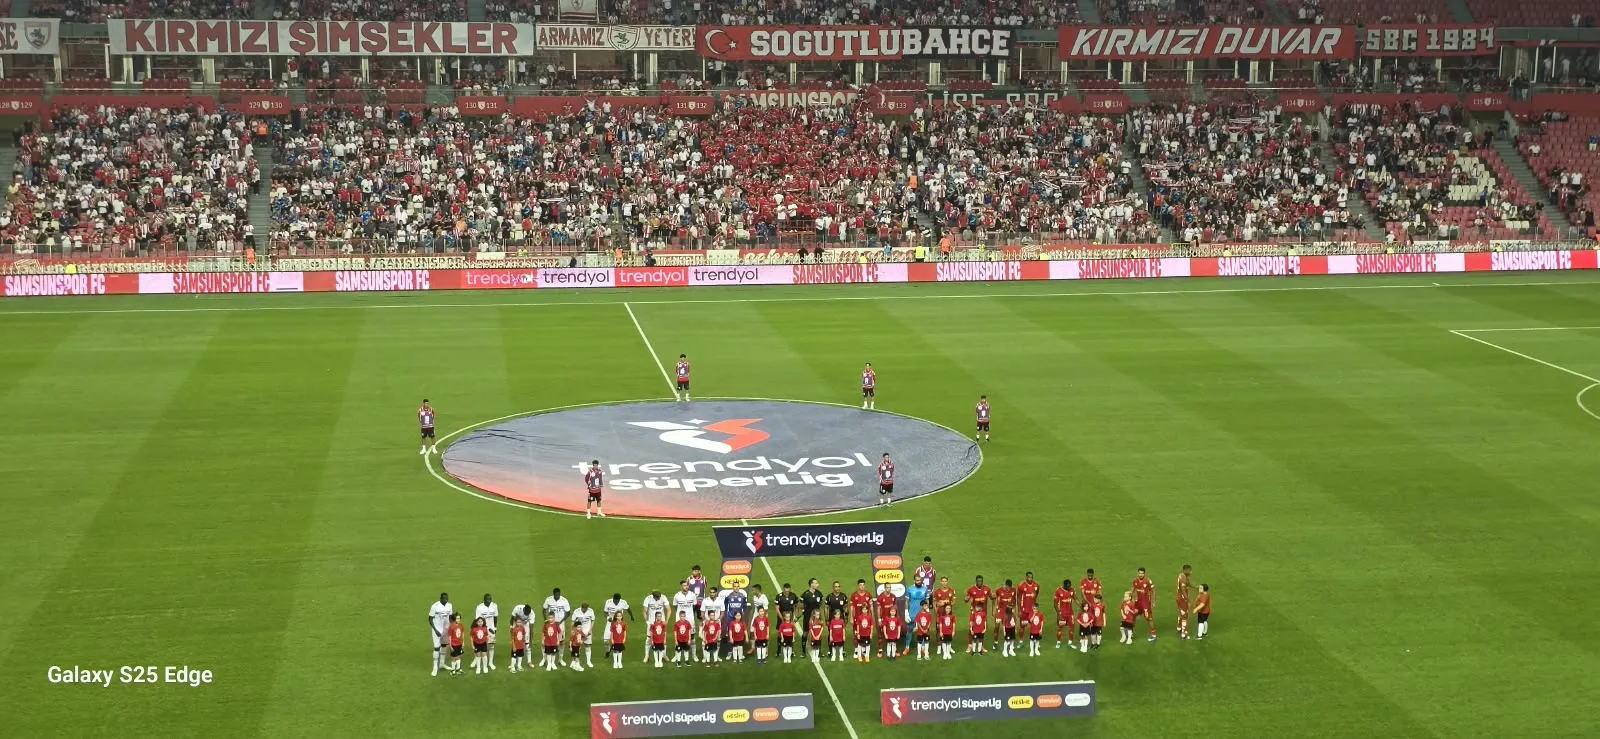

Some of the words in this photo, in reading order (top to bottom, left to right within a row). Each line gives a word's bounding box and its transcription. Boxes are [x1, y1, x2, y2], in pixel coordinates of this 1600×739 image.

[124, 20, 278, 52] KIRMIZI
[538, 26, 605, 46] ARMAMIZ
[750, 28, 1010, 56] SOGUTLUBAHCE
[1070, 28, 1210, 55] KIRMIZI
[1213, 27, 1341, 54] DUVAR
[1365, 28, 1418, 51] SBC
[1426, 28, 1494, 51] 1984
[1078, 259, 1146, 278] SAMSUNSPOR
[1150, 258, 1162, 277] FC
[1218, 256, 1286, 276] SAMSUNSPOR
[1288, 256, 1300, 274] FC
[1356, 254, 1422, 273] SAMSUNSPOR
[1426, 253, 1437, 272] FC
[1491, 251, 1557, 271] SAMSUNSPOR
[1559, 250, 1572, 269] FC
[335, 270, 413, 291] SAMSUNSPOR
[416, 269, 430, 289] FC
[543, 270, 610, 285] trendyol
[619, 268, 685, 284] trendyol
[694, 267, 759, 283] trendyol
[793, 263, 863, 284] SAMSUNSPOR
[866, 263, 879, 282] FC
[937, 262, 1006, 281] SAMSUNSPOR
[1009, 261, 1021, 279] FC
[5, 273, 88, 296] SAMSUNSPOR
[91, 273, 105, 294] FC
[173, 272, 251, 293] SAMSUNSPOR
[257, 272, 270, 292] FC
[571, 453, 872, 476] trendyol
[766, 531, 831, 548] trendyol
[911, 697, 961, 713] trendyol
[621, 711, 674, 727] trendyol
